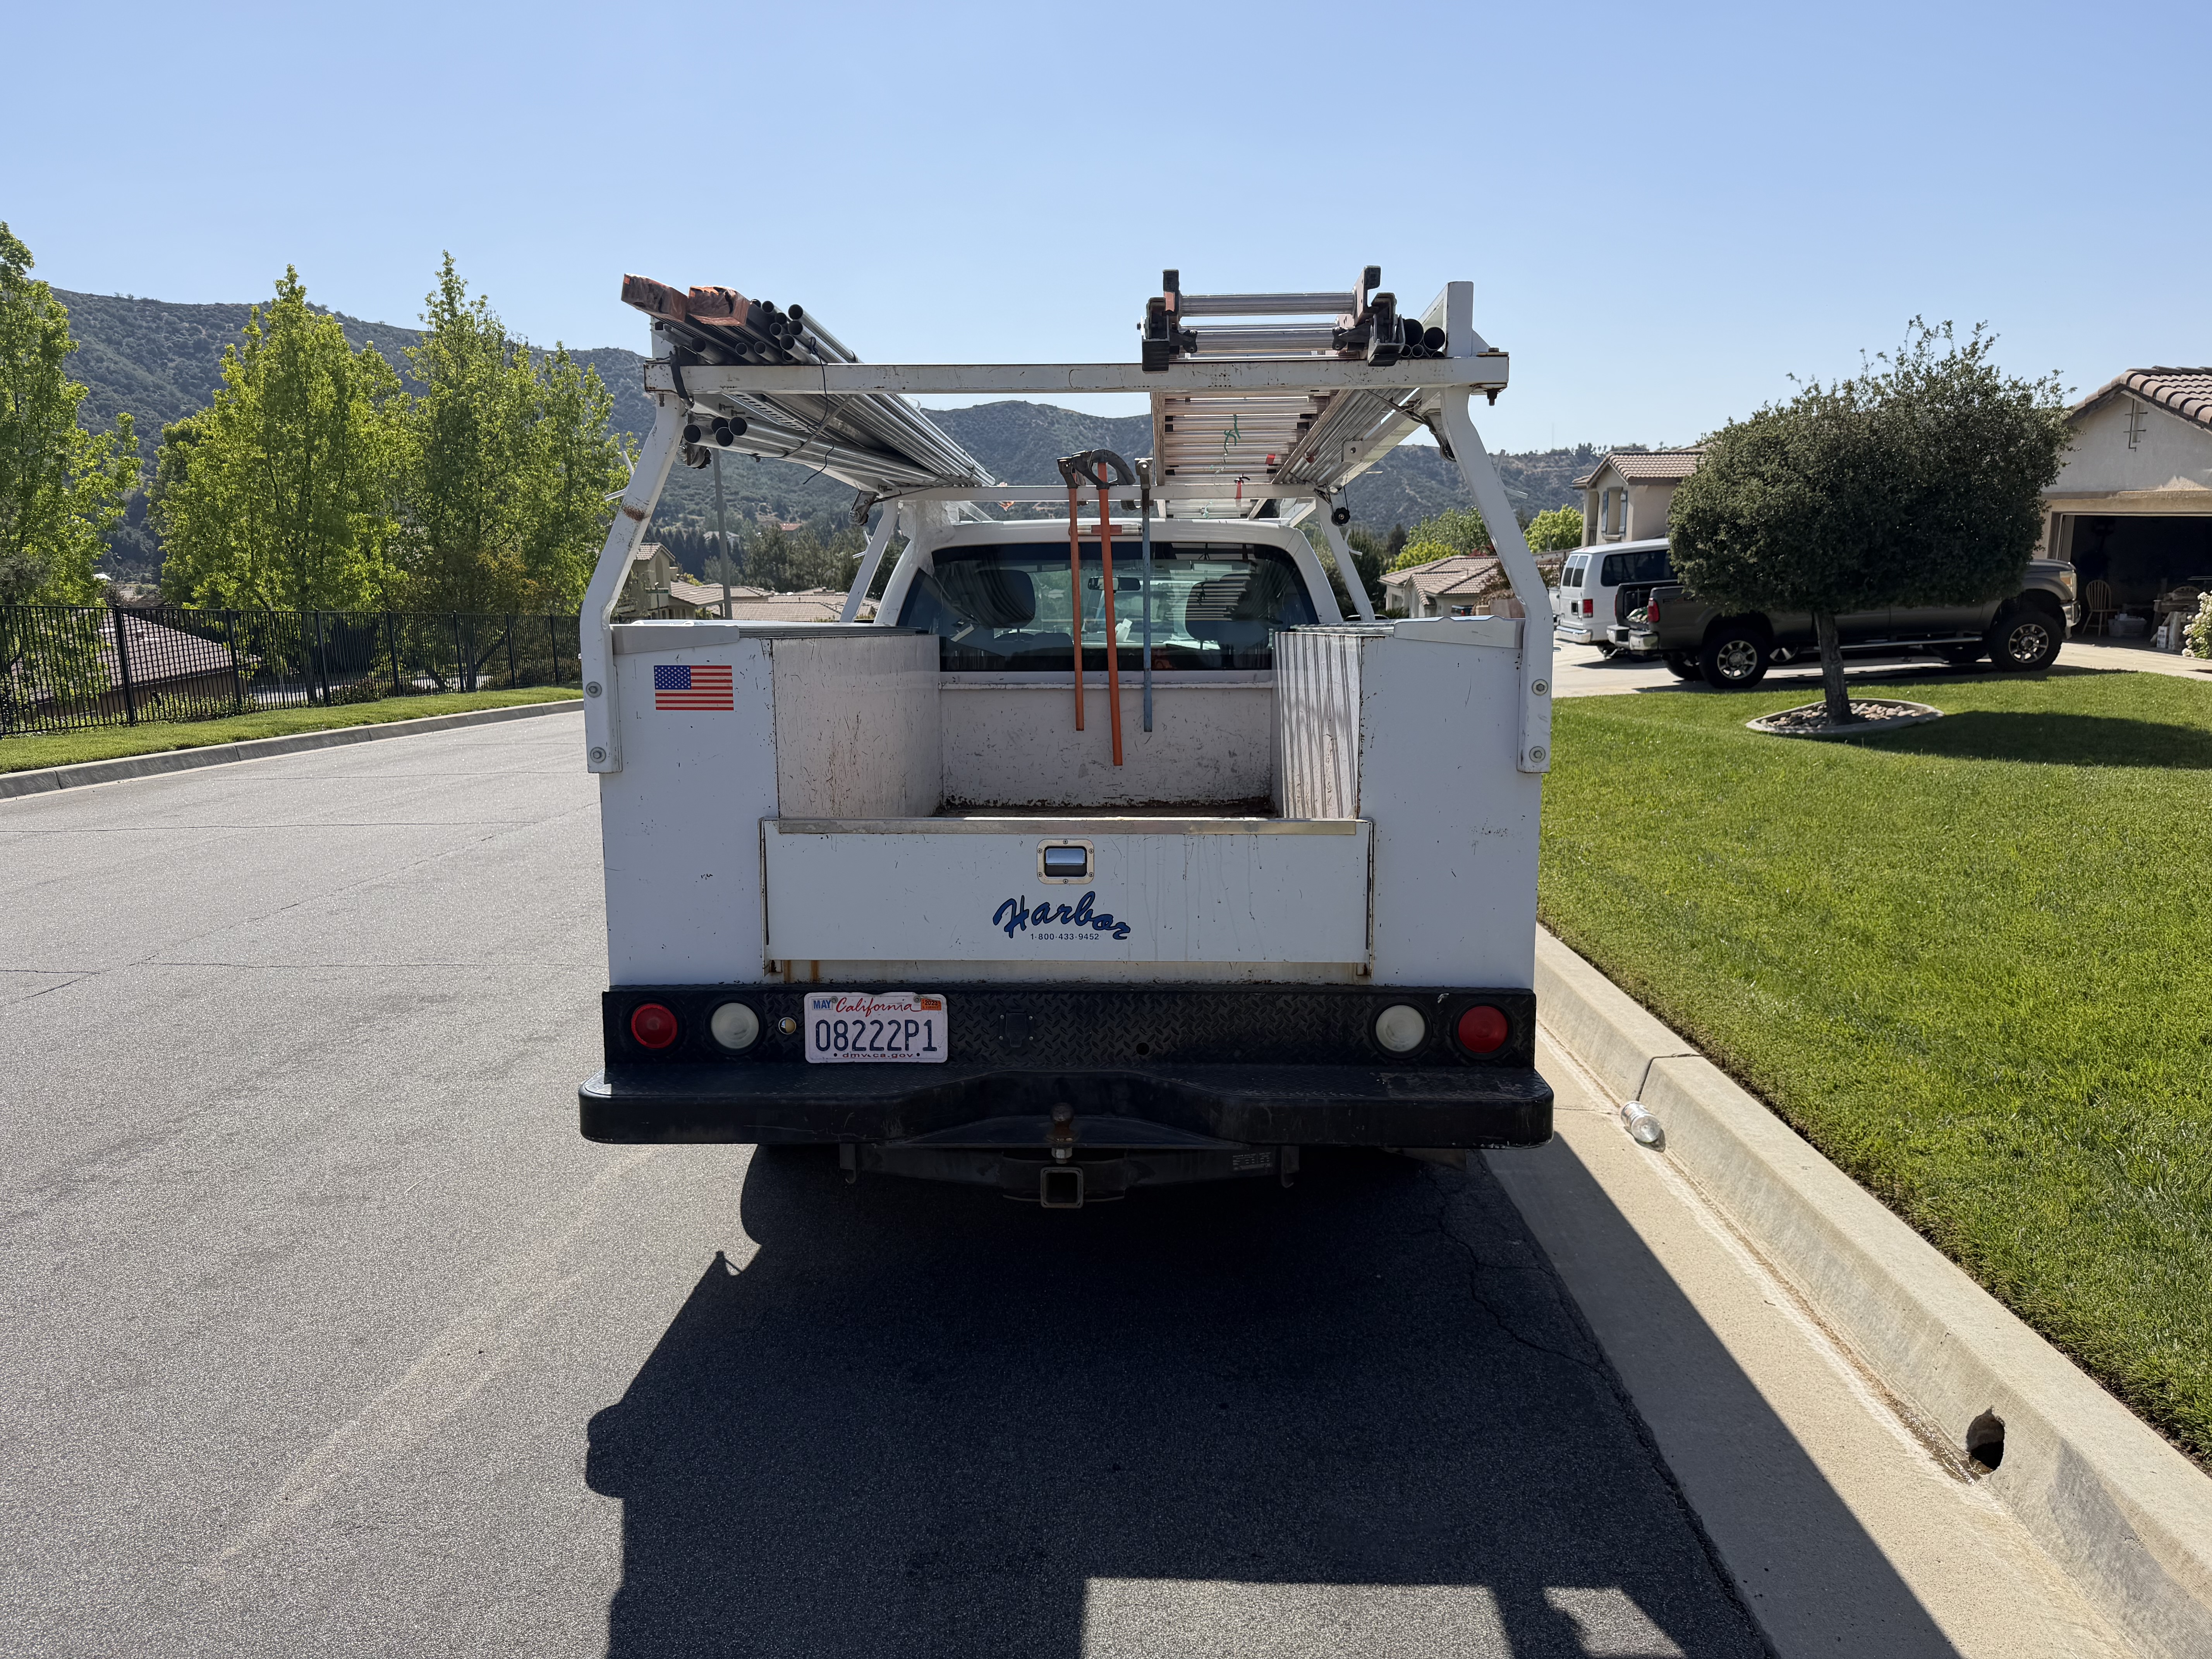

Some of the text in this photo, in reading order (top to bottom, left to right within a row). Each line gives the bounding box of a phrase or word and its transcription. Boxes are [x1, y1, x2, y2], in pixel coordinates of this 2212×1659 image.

[993, 891, 1131, 940] Harbor
[813, 1000, 831, 1009] MAY
[836, 997, 922, 1017] California
[816, 1020, 937, 1051] 08222P1
